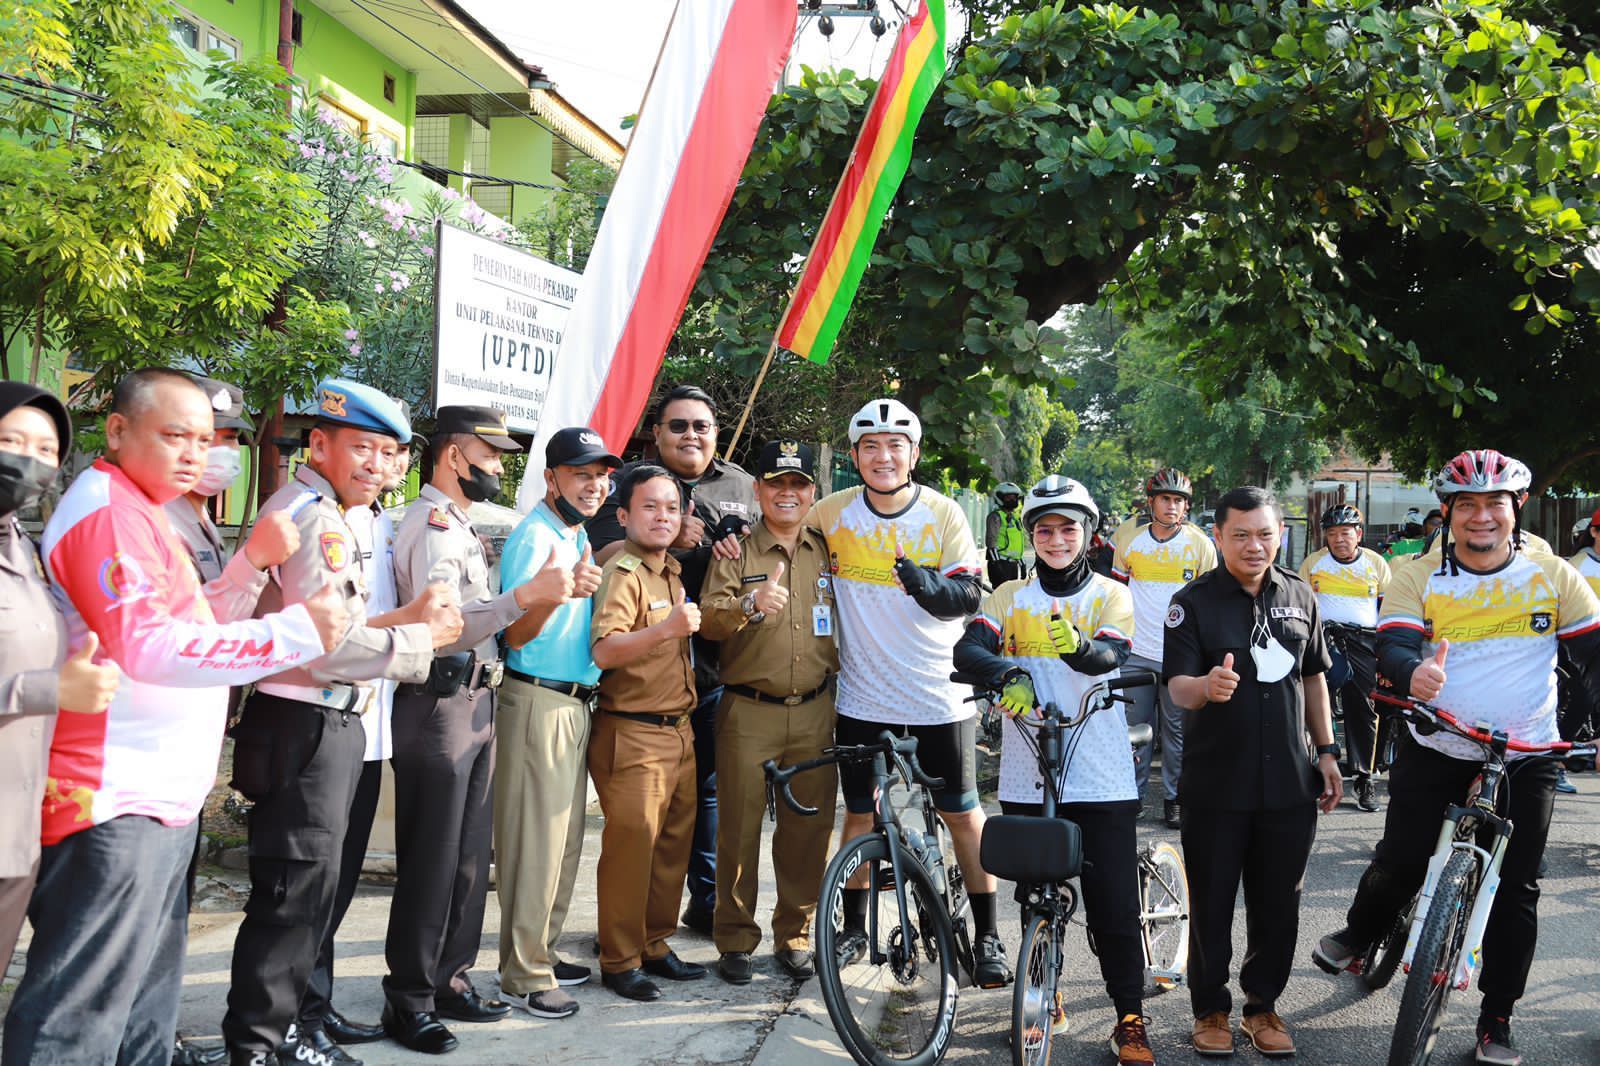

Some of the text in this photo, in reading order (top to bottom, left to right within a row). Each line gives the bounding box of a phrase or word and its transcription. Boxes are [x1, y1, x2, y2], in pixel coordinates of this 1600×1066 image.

[473, 253, 522, 284] PEMERINTAH
[523, 271, 541, 292] KOTA
[506, 296, 538, 319] KANTOR
[456, 302, 477, 322] UNIT
[480, 309, 526, 336] PELAKSANA
[527, 323, 554, 344] TEKNIS
[1534, 617, 1548, 628] 76
[178, 638, 274, 659] LPM
